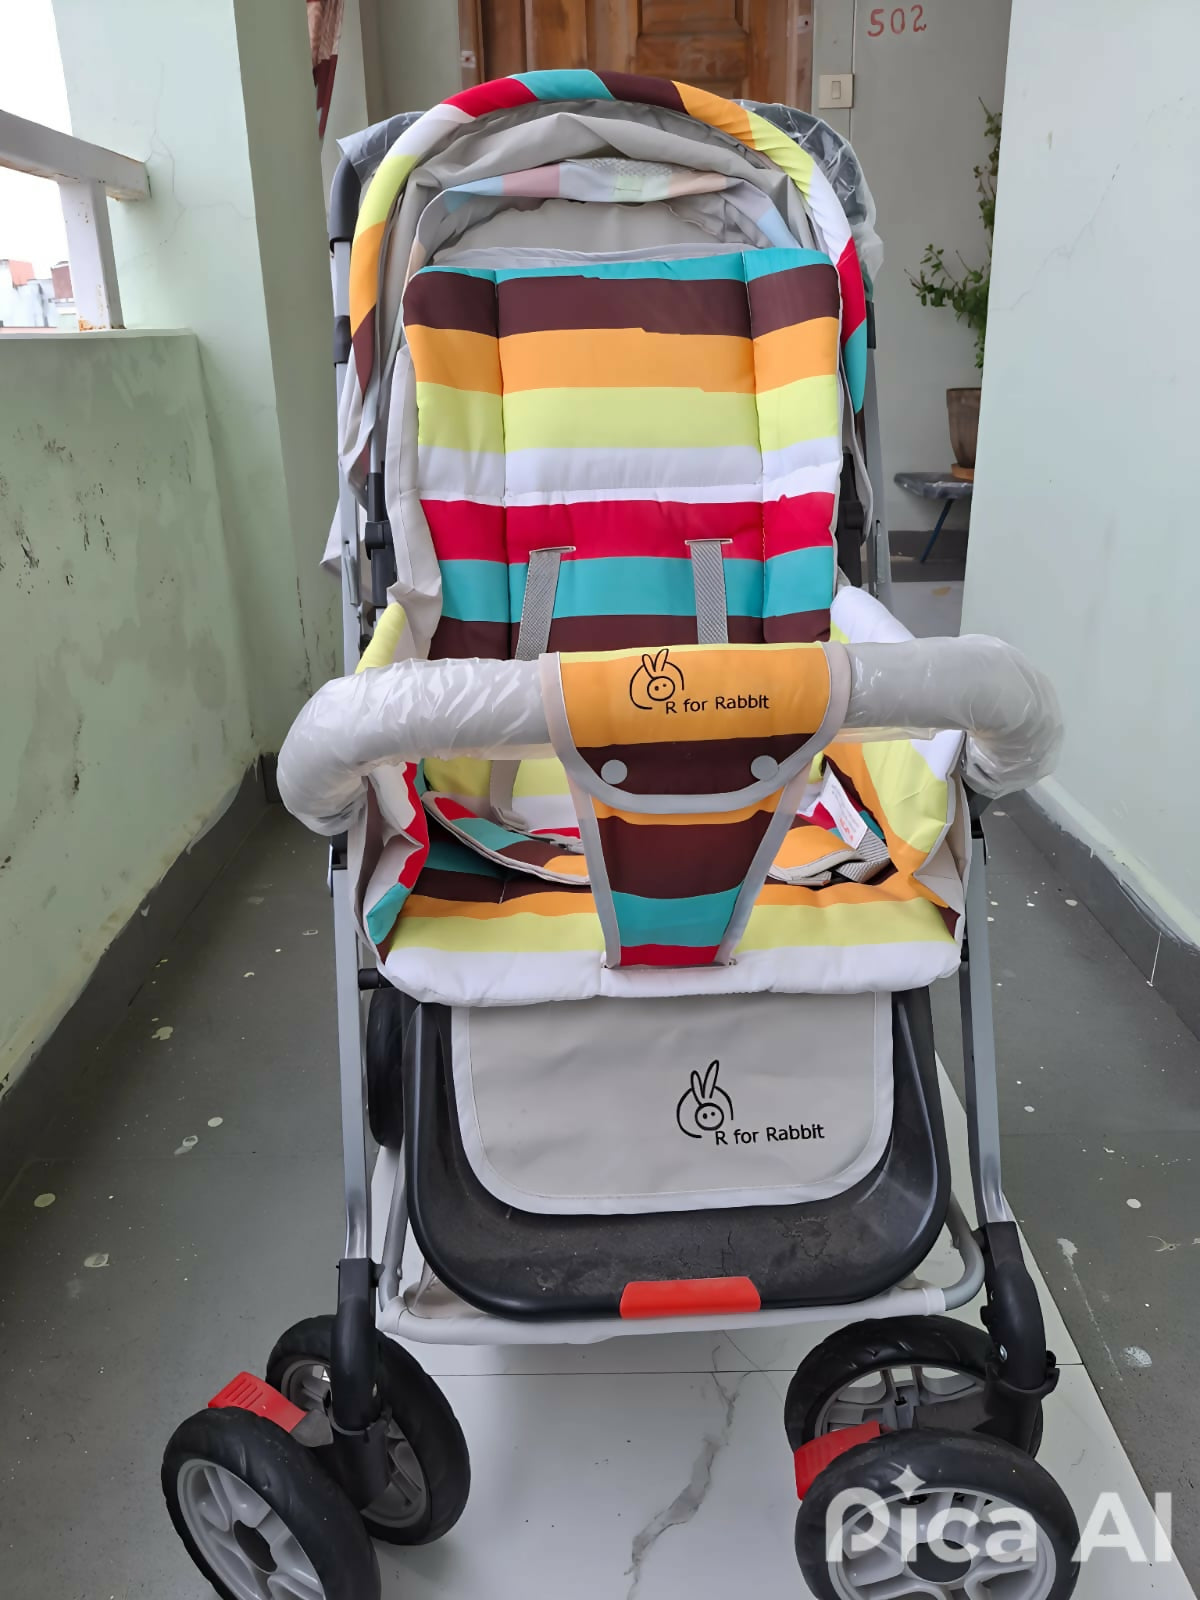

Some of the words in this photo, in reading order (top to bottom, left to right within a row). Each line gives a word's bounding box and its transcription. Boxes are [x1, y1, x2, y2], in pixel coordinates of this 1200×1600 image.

[867, 4, 927, 37] 502
[665, 700, 678, 715] R
[683, 698, 708, 713] for
[715, 694, 770, 710] Rabbit
[715, 1130, 728, 1146] R
[733, 1128, 760, 1145] for
[766, 1123, 825, 1142] Rabbit
